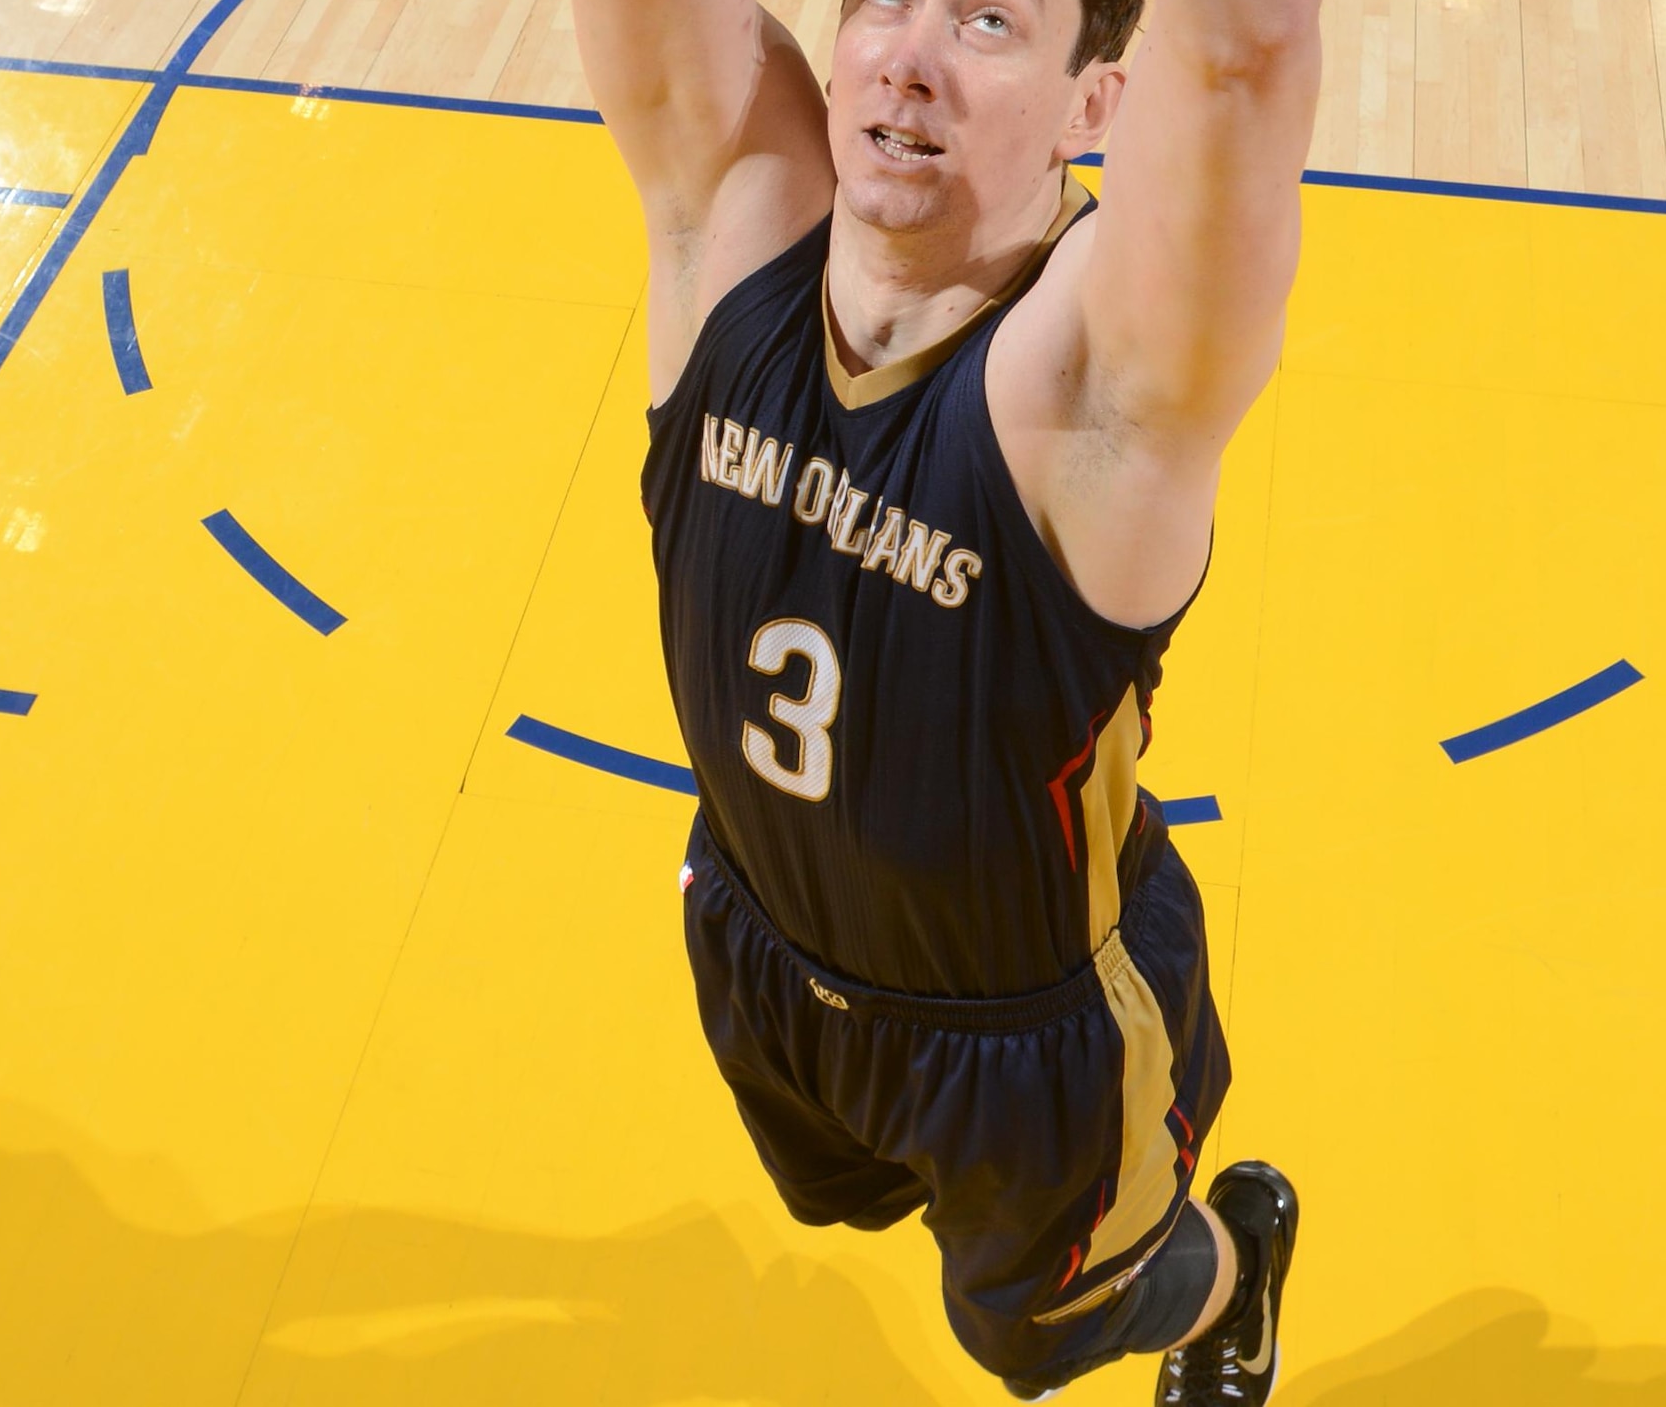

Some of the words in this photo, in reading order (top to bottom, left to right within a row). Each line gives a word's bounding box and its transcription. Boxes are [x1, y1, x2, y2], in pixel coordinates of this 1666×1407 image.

[701, 412, 795, 508] NEW
[793, 456, 983, 609] ORLANS
[741, 617, 842, 803] 3
